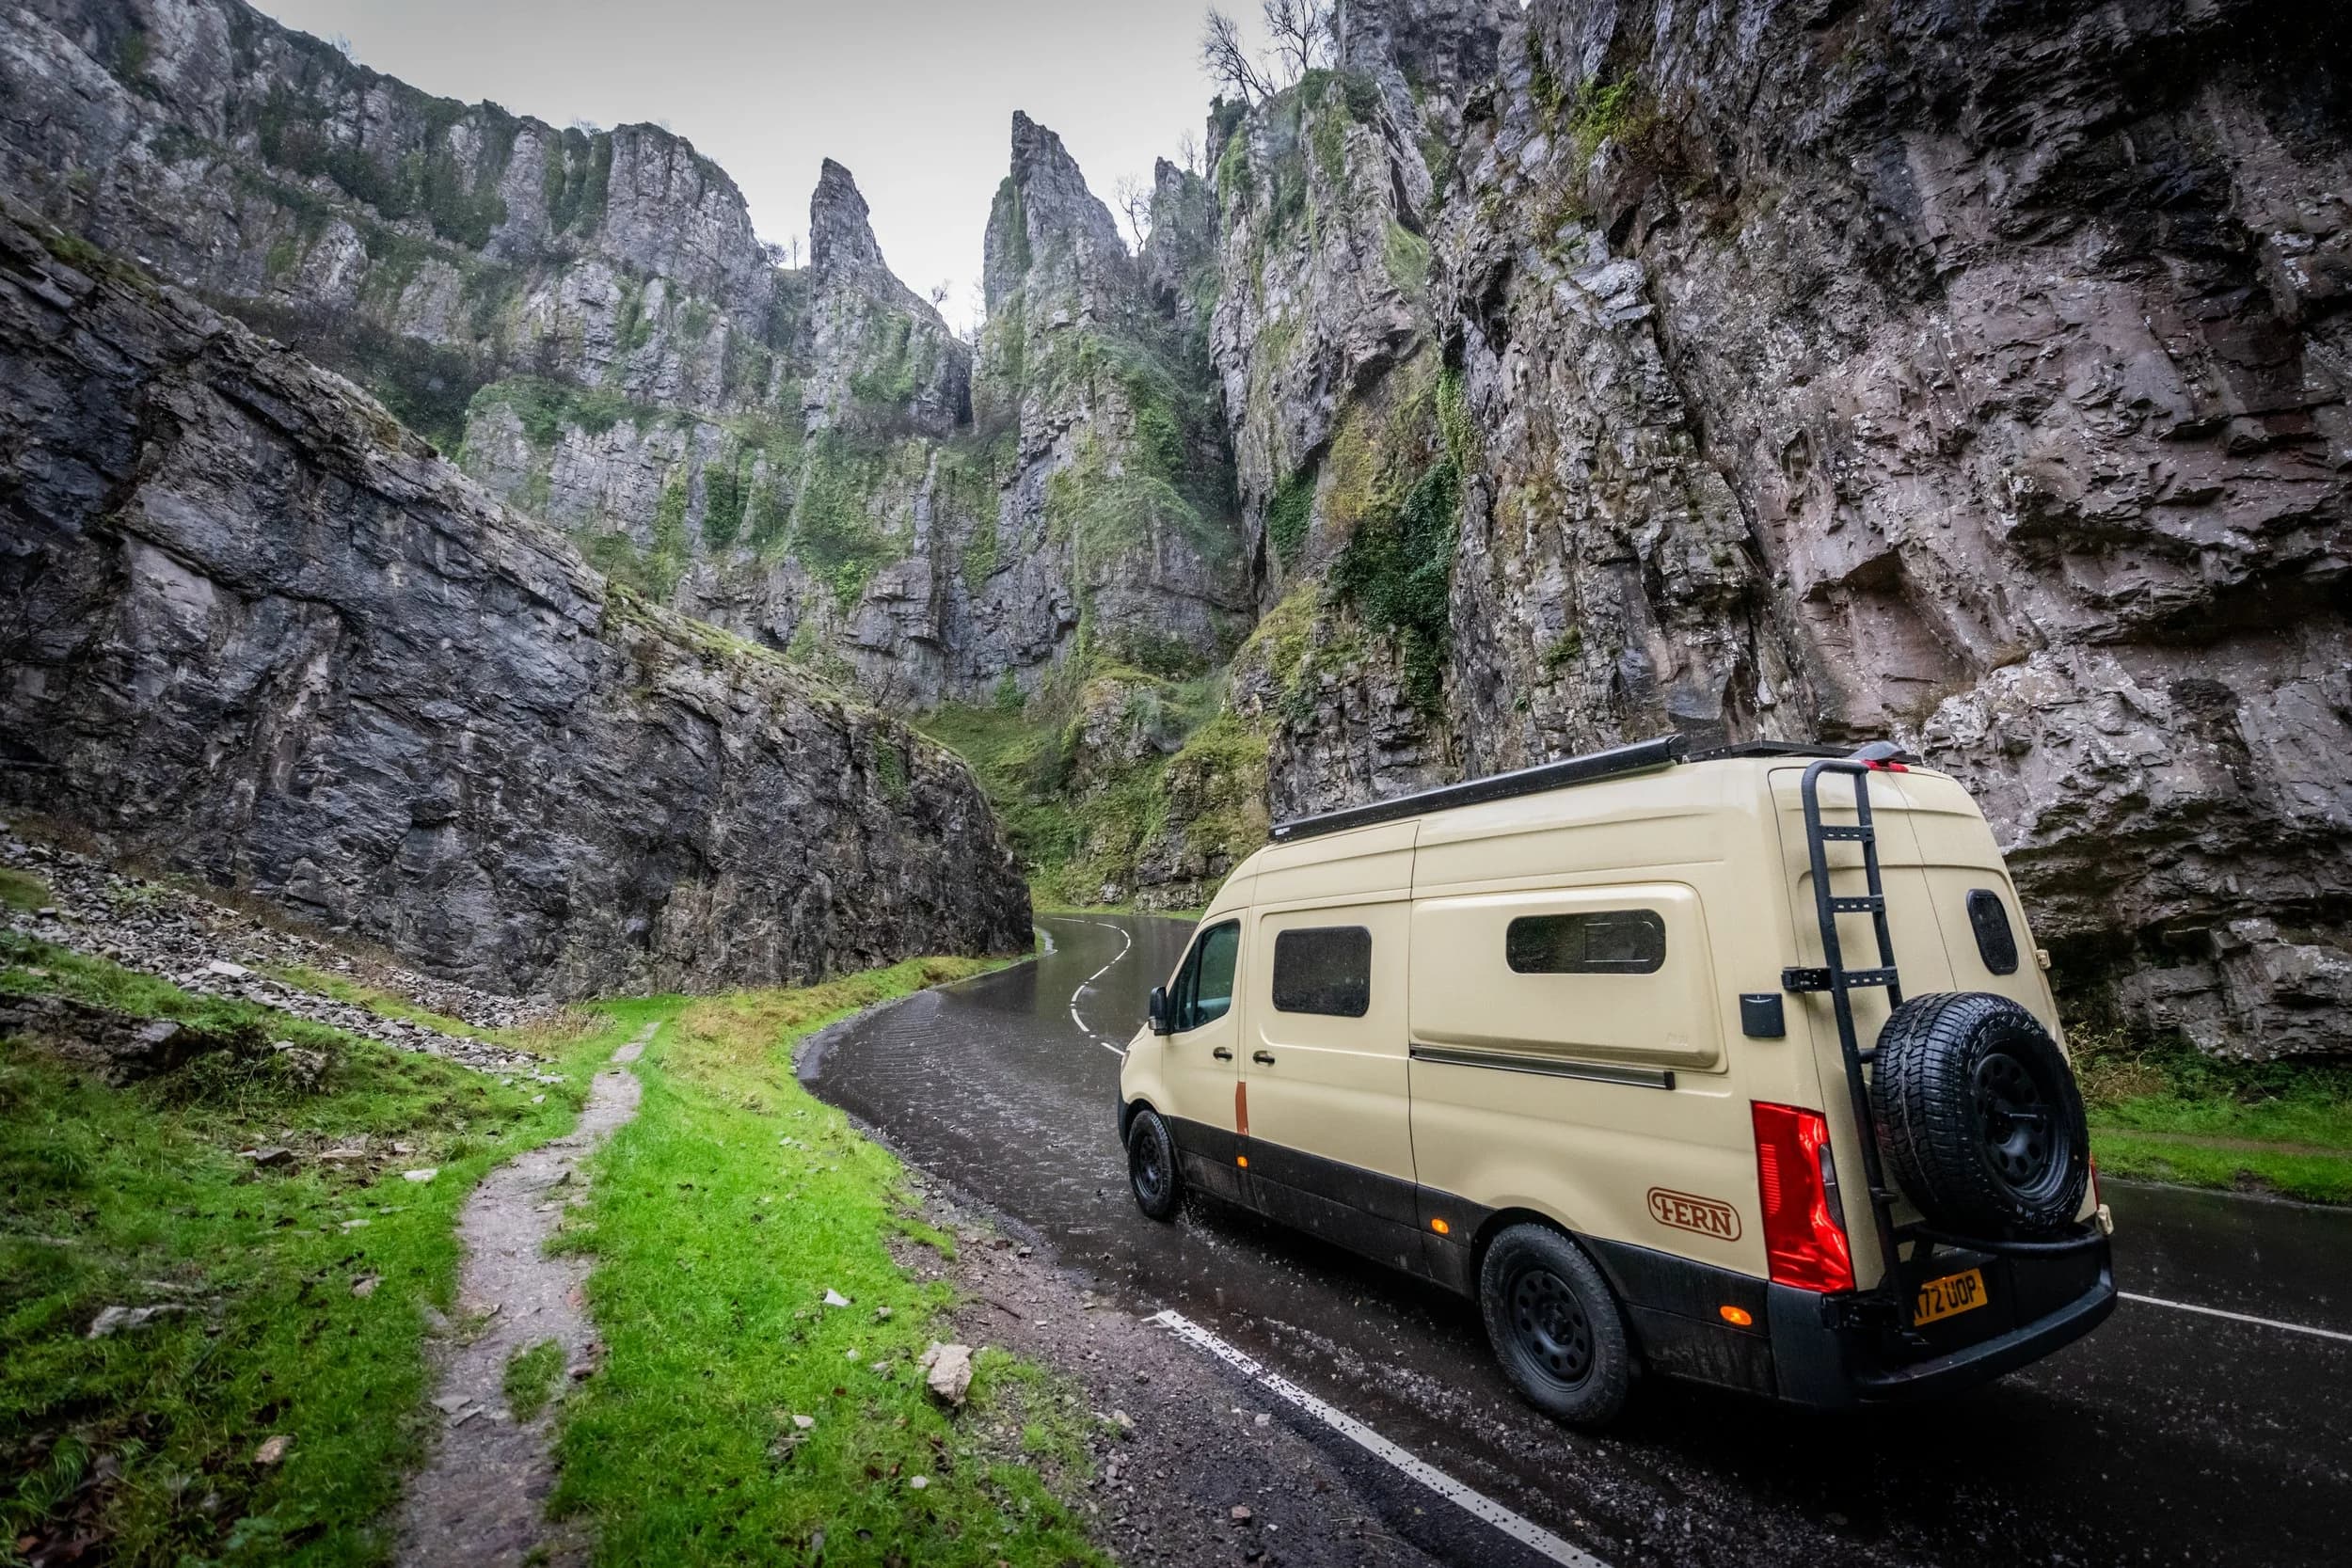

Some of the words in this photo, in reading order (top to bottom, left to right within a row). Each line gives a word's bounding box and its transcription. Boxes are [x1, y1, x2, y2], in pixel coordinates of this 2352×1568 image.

[1652, 1193, 1731, 1236] FERN
[1915, 1286, 1945, 1318] 72
[1944, 1275, 1976, 1308] UOP
